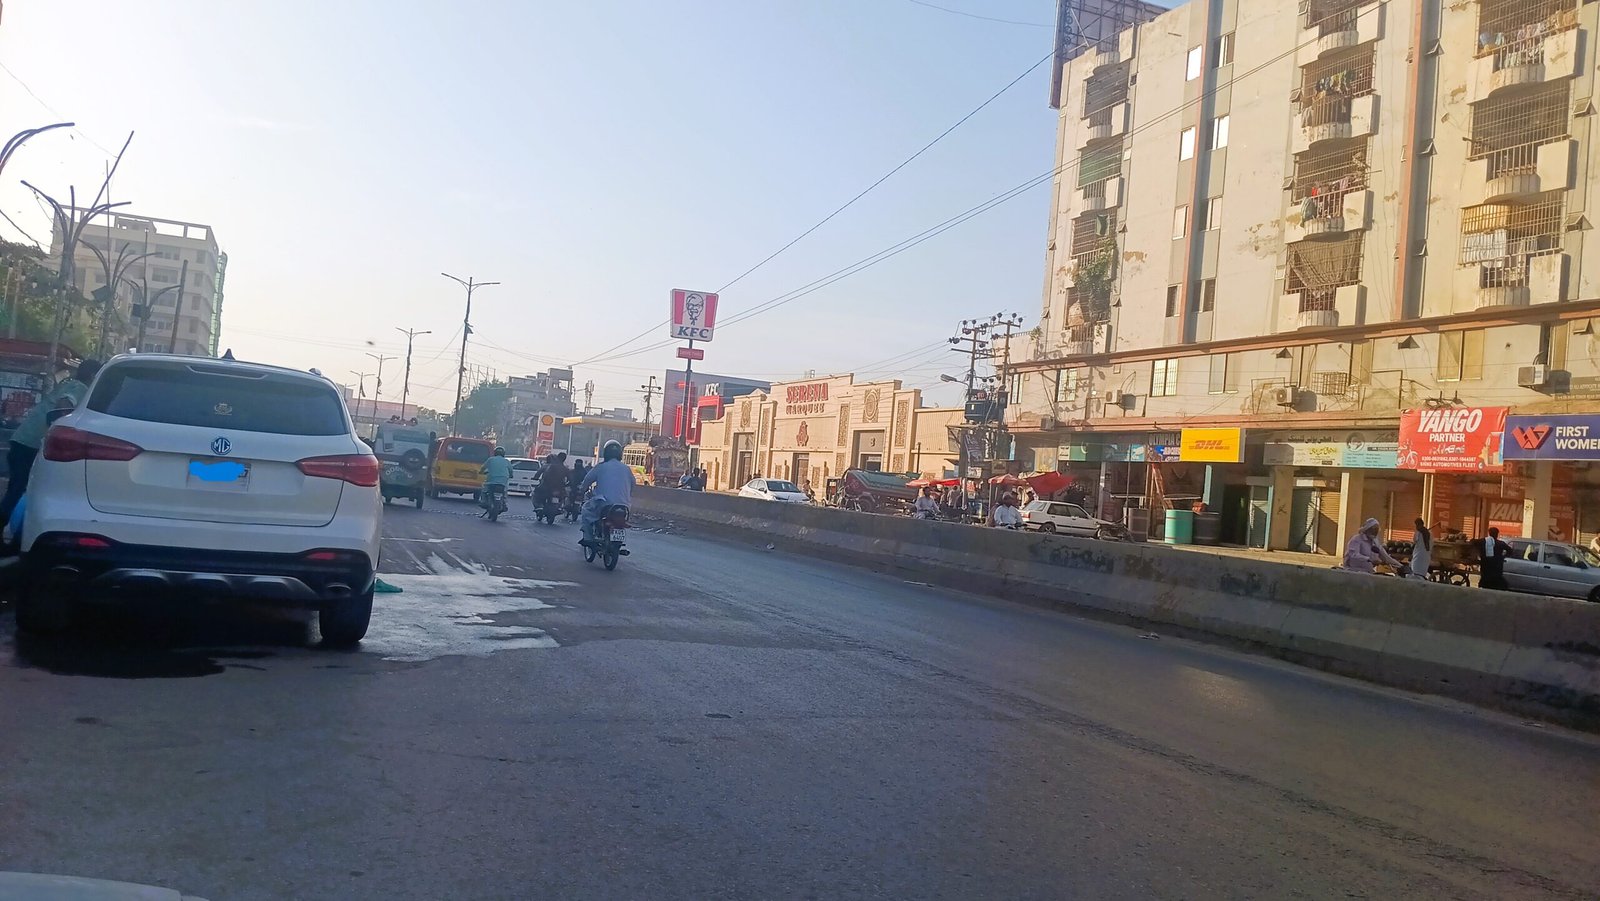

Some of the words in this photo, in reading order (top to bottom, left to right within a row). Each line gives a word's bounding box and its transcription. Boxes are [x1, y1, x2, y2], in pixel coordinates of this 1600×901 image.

[677, 326, 709, 338] KFC
[705, 383, 719, 397] KFC
[786, 383, 828, 404] SERENA
[1417, 408, 1483, 433] YANGO
[1429, 433, 1466, 443] PARTNER
[1555, 426, 1589, 437] FIRST
[213, 438, 231, 453] MG
